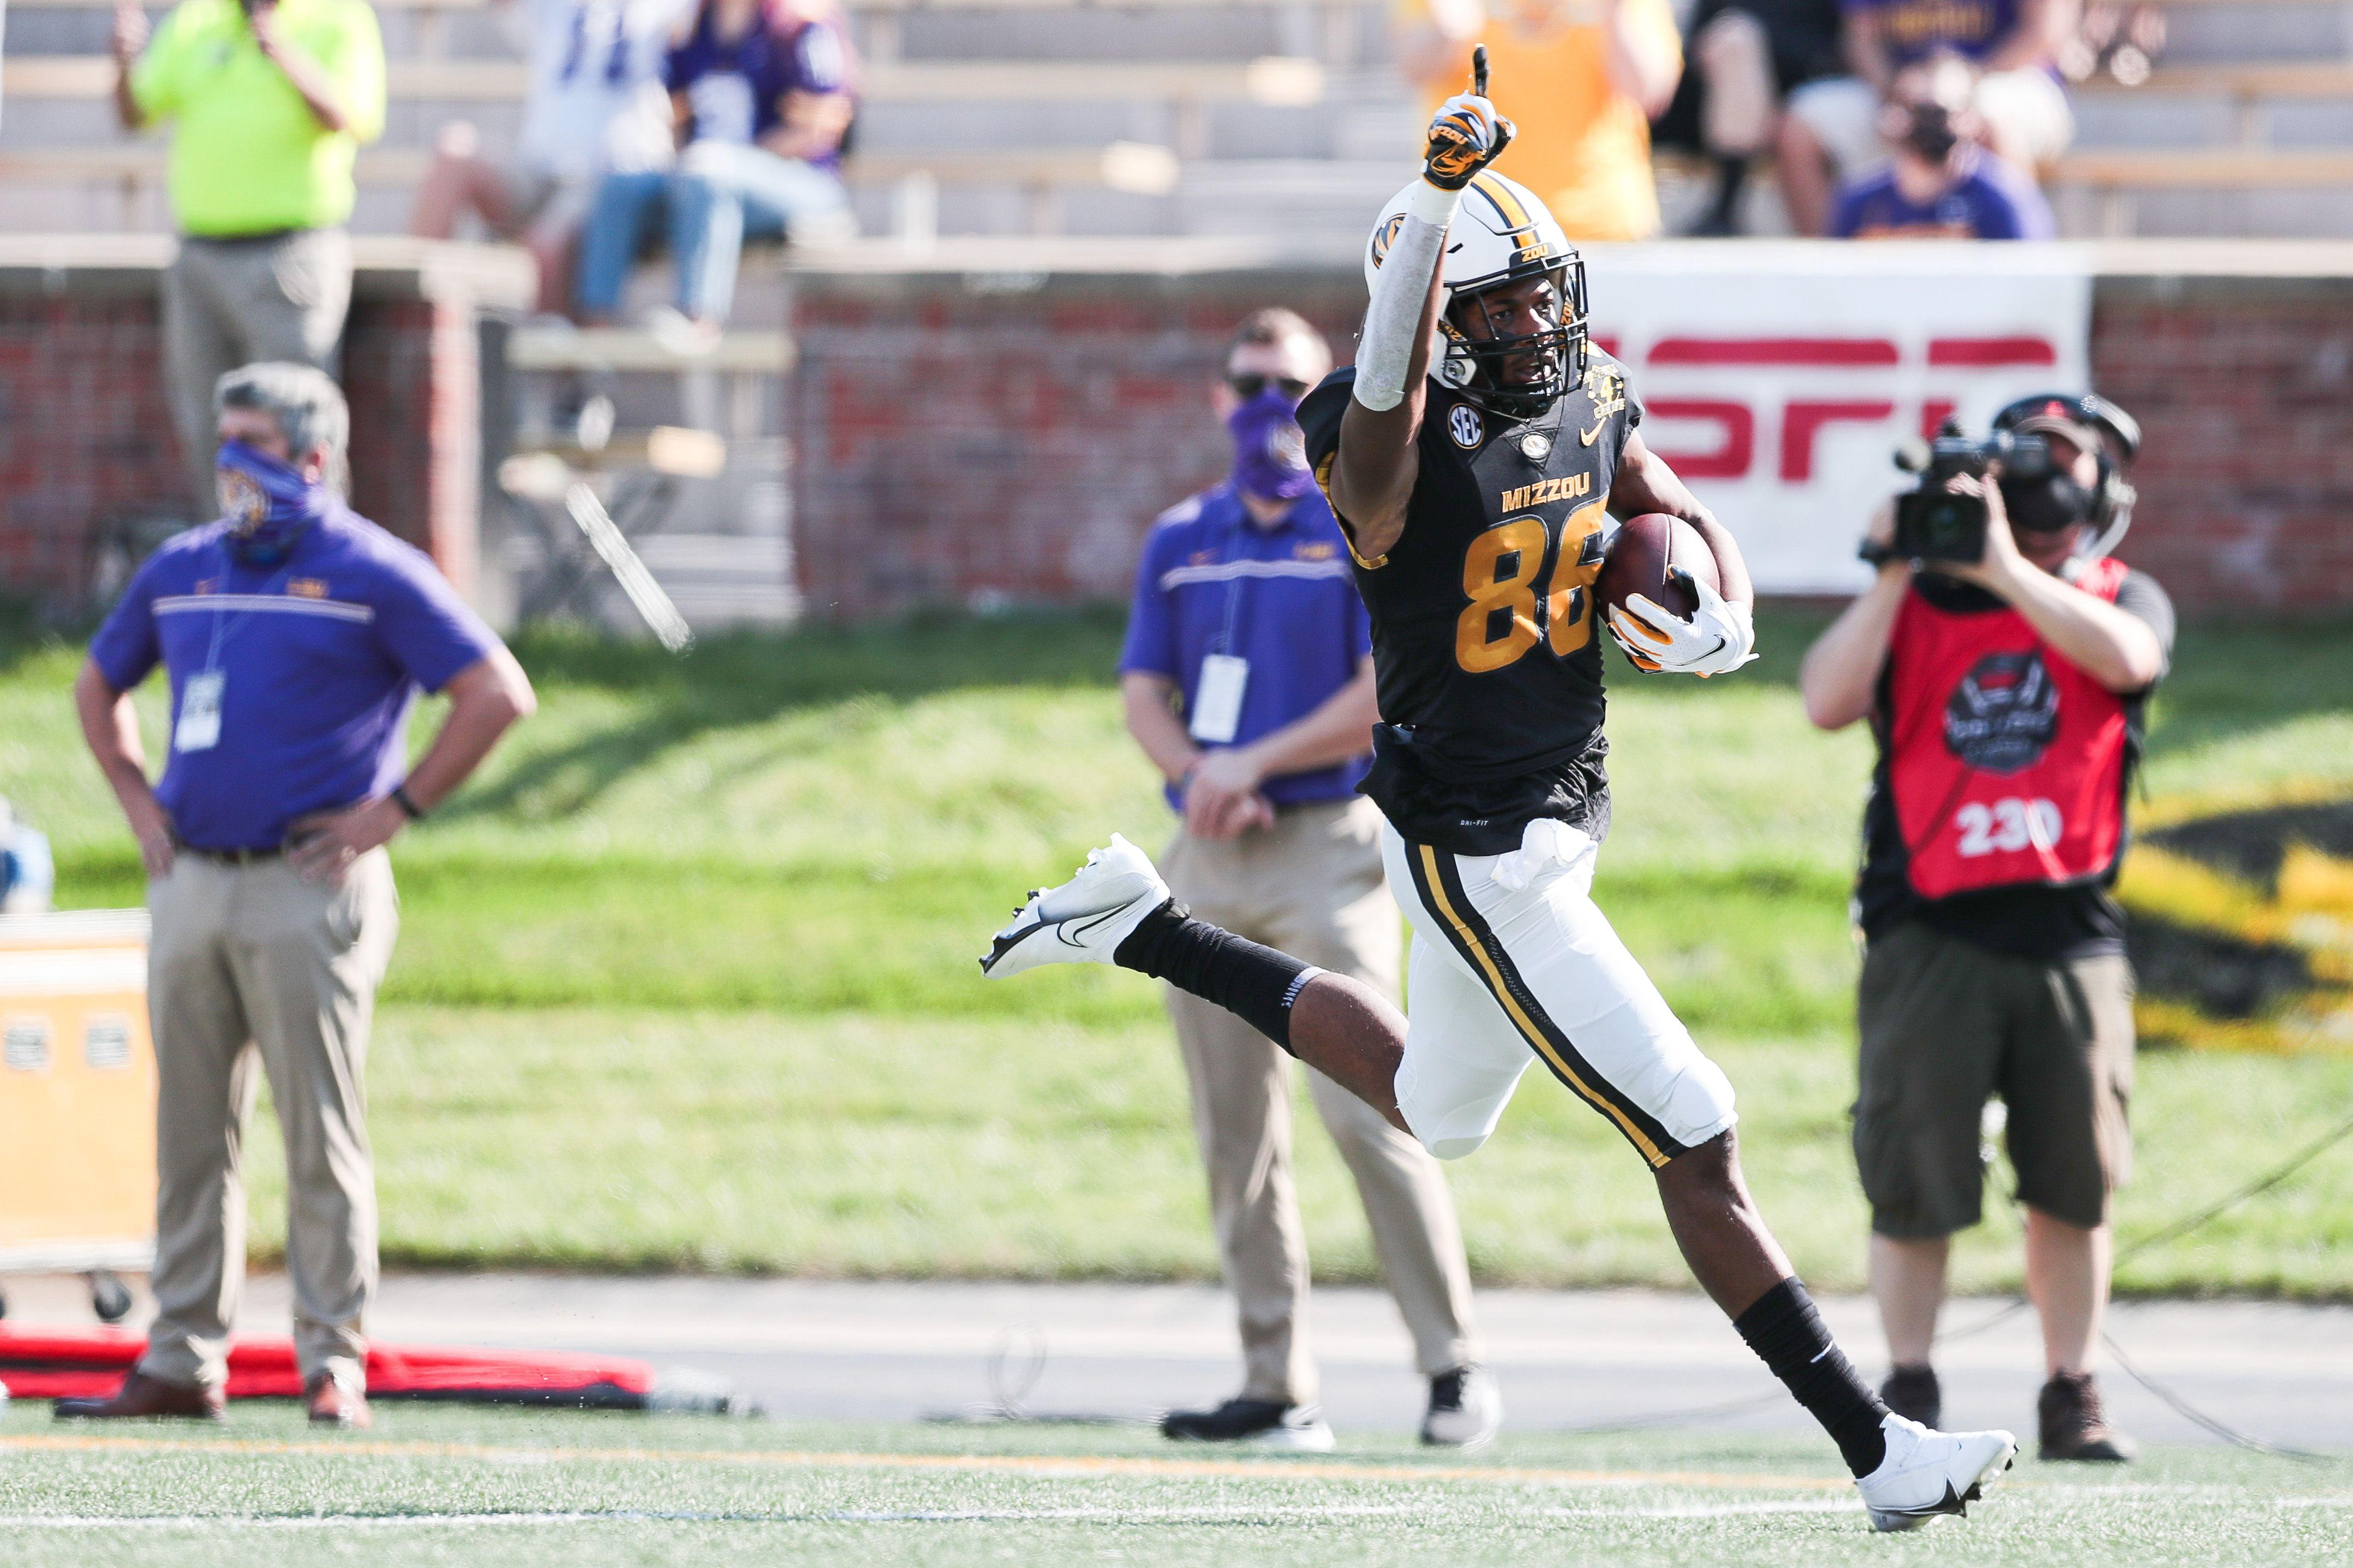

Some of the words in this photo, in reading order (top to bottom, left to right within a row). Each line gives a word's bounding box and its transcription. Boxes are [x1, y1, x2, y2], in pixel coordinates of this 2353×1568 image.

[1521, 244, 1549, 263] ZOU
[1449, 406, 1482, 446] SEC
[1586, 333, 2059, 483] SP
[1501, 471, 1590, 513] MIZZOU
[1455, 489, 1609, 675] 86
[1955, 796, 2063, 859] 230
